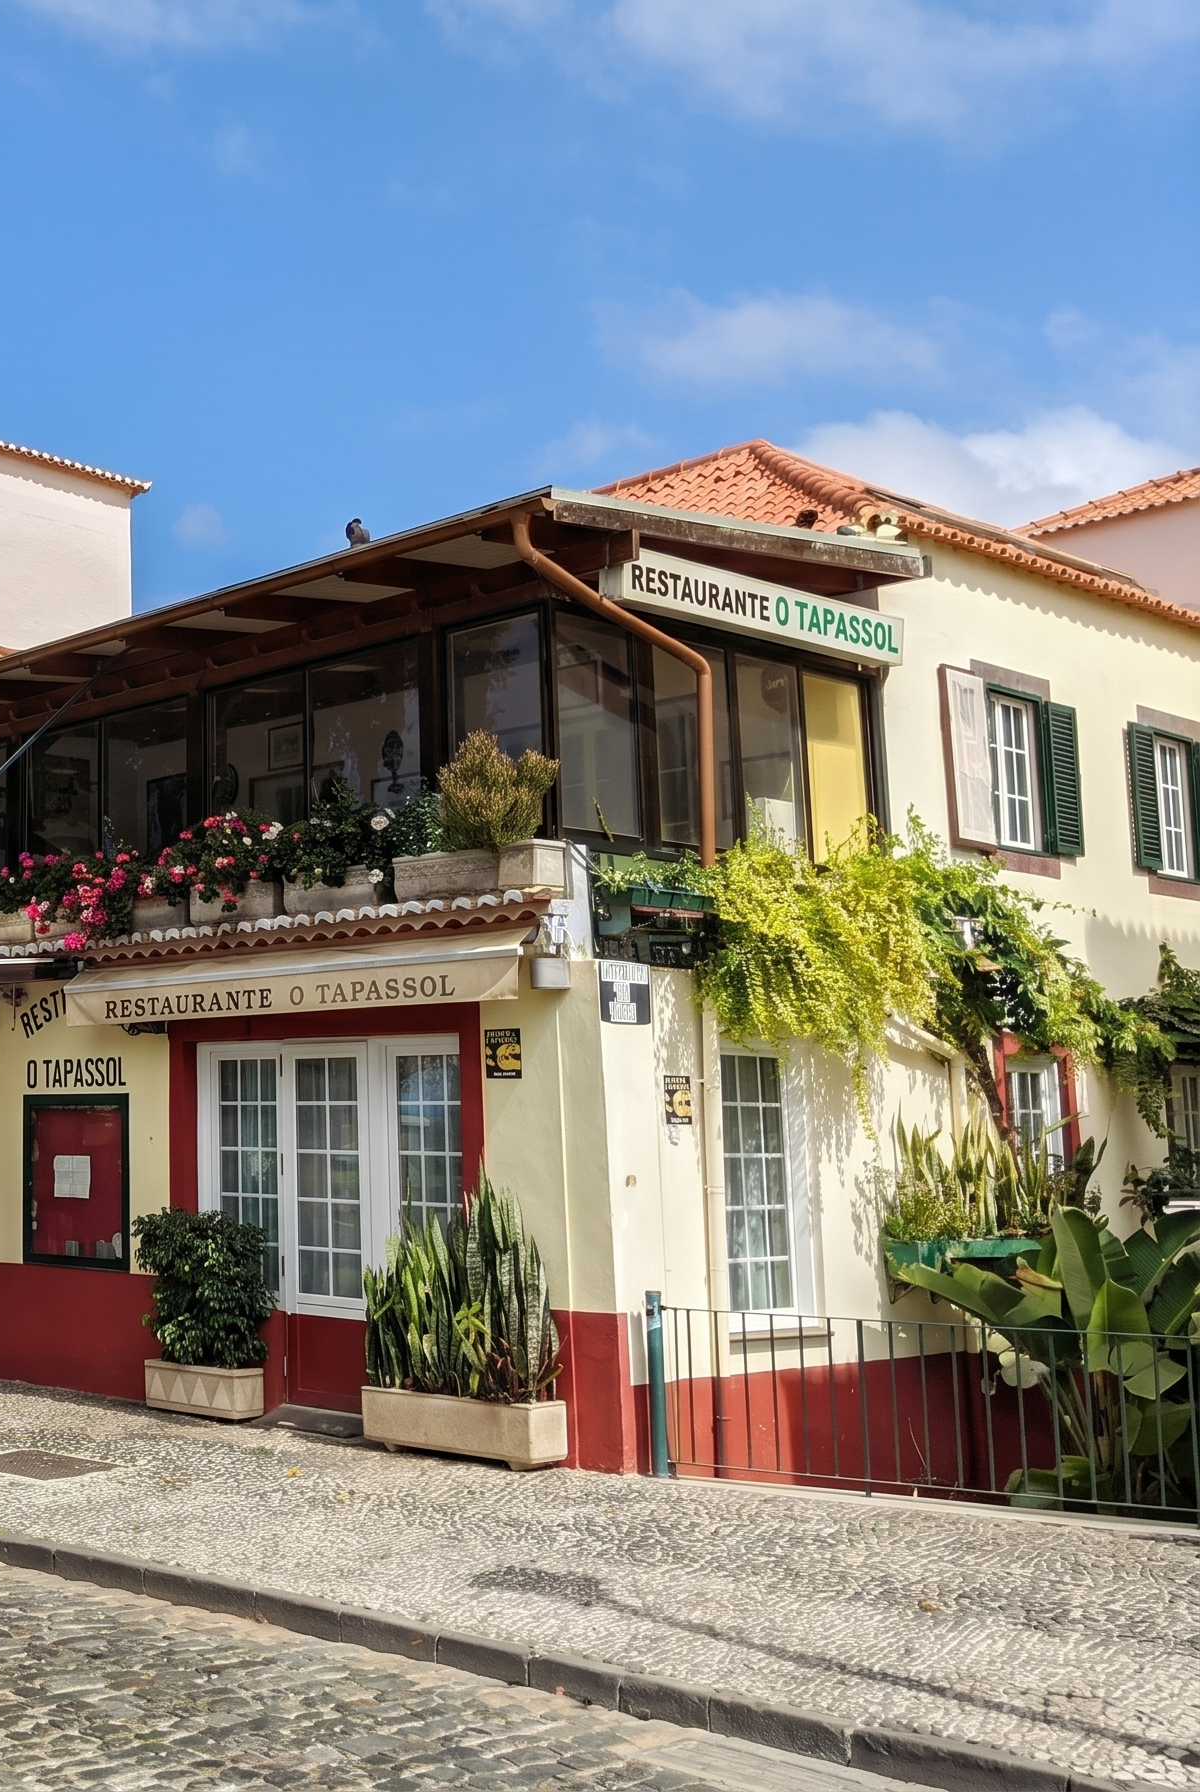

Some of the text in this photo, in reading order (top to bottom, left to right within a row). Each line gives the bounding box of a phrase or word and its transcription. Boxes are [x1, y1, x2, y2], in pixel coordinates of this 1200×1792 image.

[631, 563, 899, 654] RESTAURANTE O TAPASSOL
[105, 975, 456, 1019] RESTAURANTE O TAPASSOL
[27, 1056, 127, 1089] O TAPASSOL
